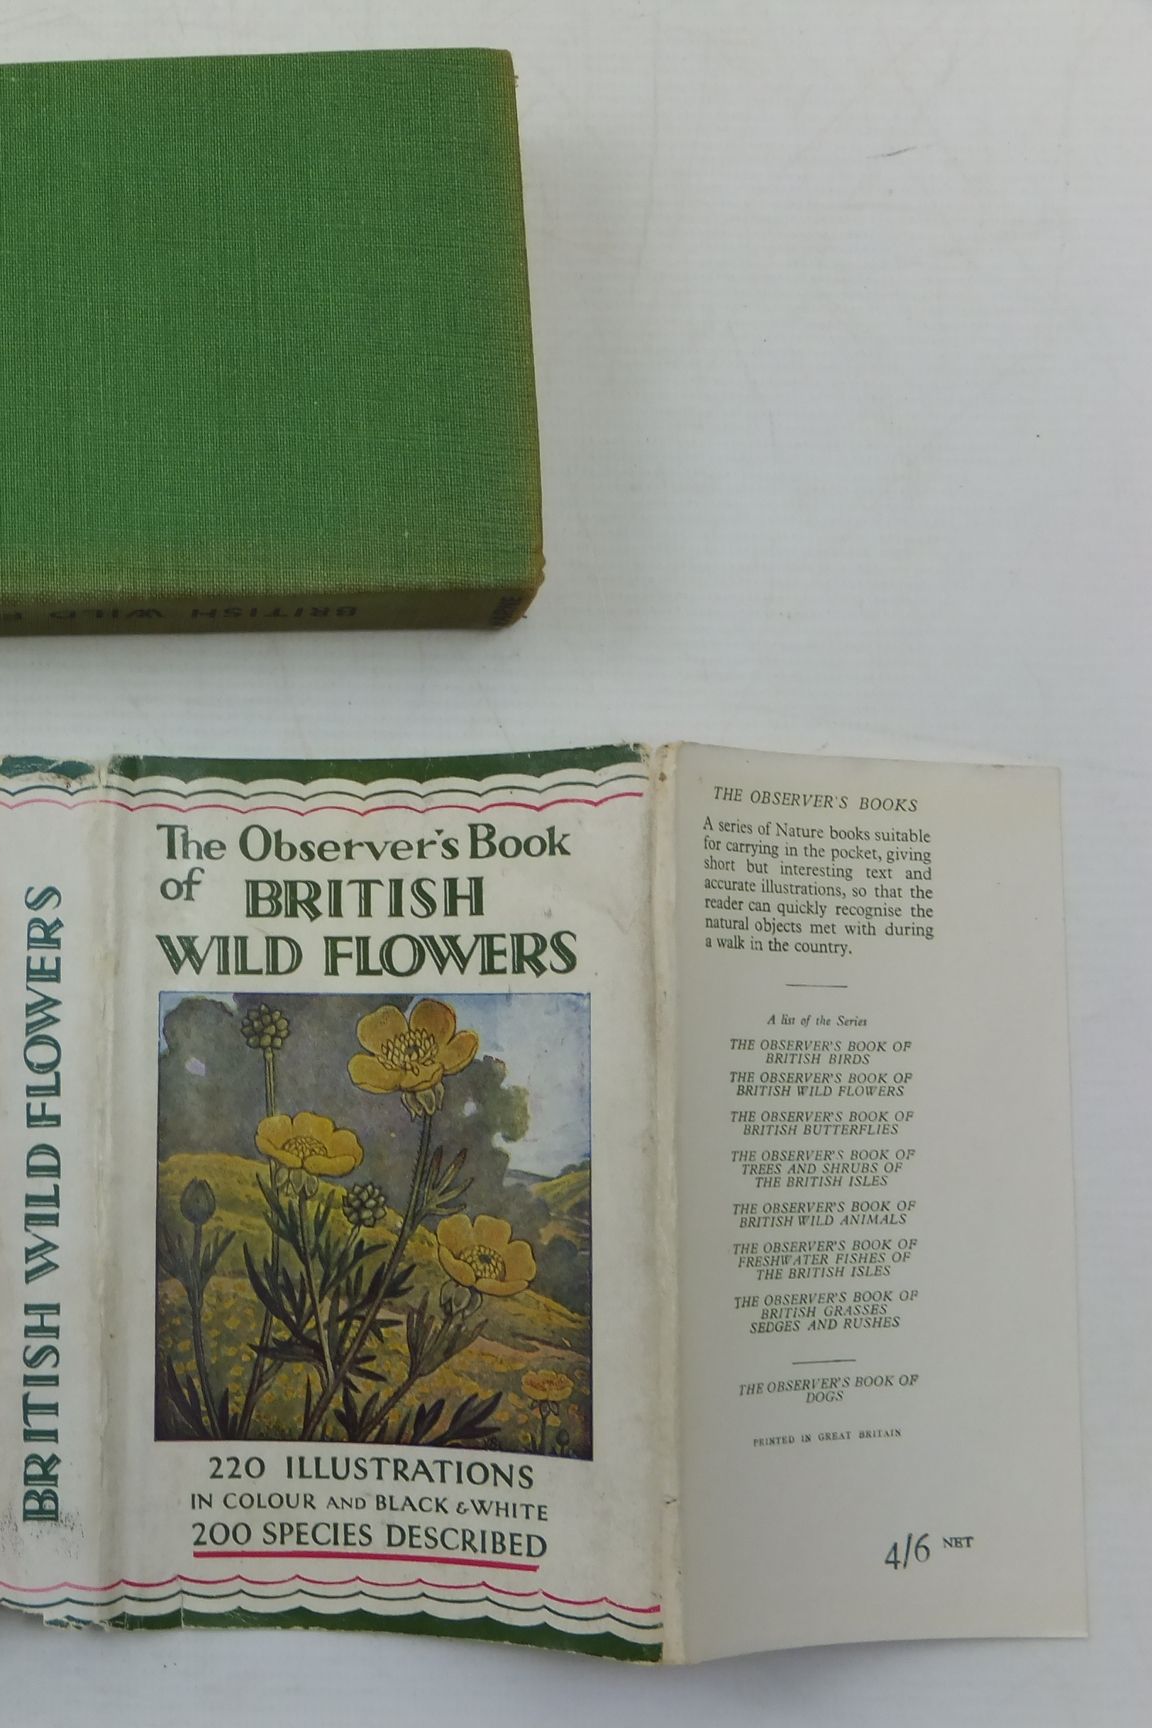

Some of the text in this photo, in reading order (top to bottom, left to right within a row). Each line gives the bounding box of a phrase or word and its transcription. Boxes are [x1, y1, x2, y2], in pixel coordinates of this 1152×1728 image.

[49, 608, 165, 621] WILD
[190, 605, 359, 618] BRITISH
[713, 785, 919, 813] THE OBSERVER'S BOOKS
[156, 822, 572, 863] The Observer's Book
[702, 815, 932, 844] A series of Nature books suitable
[703, 834, 932, 865] for carrying in the pocket, giving
[703, 854, 933, 882] short but interesting text and
[159, 866, 485, 922] of BRITISH
[703, 877, 934, 900] accurate illustrations, so that the
[704, 895, 934, 920] reader can quickly recognise the
[704, 915, 935, 941] natural objects met with during
[155, 929, 578, 978] WILD FLOWERS
[704, 934, 853, 958] a walk in the country.
[730, 1110, 915, 1123] THE OBSERVER'S BOOK OF
[742, 1123, 899, 1137] BRITISH BUTTERFLIES
[20, 884, 64, 1525] BRITISH WILD FLOWERS
[209, 1455, 534, 1490] 220 ILLUSTRATIONS
[190, 1492, 213, 1511] IN
[222, 1492, 317, 1511] COLOUR
[326, 1496, 367, 1511] AND
[375, 1494, 449, 1515] BLACK
[192, 1522, 548, 1559] 200 SPECIES DESCRIBED
[884, 1532, 975, 1571] 4/6 NET
